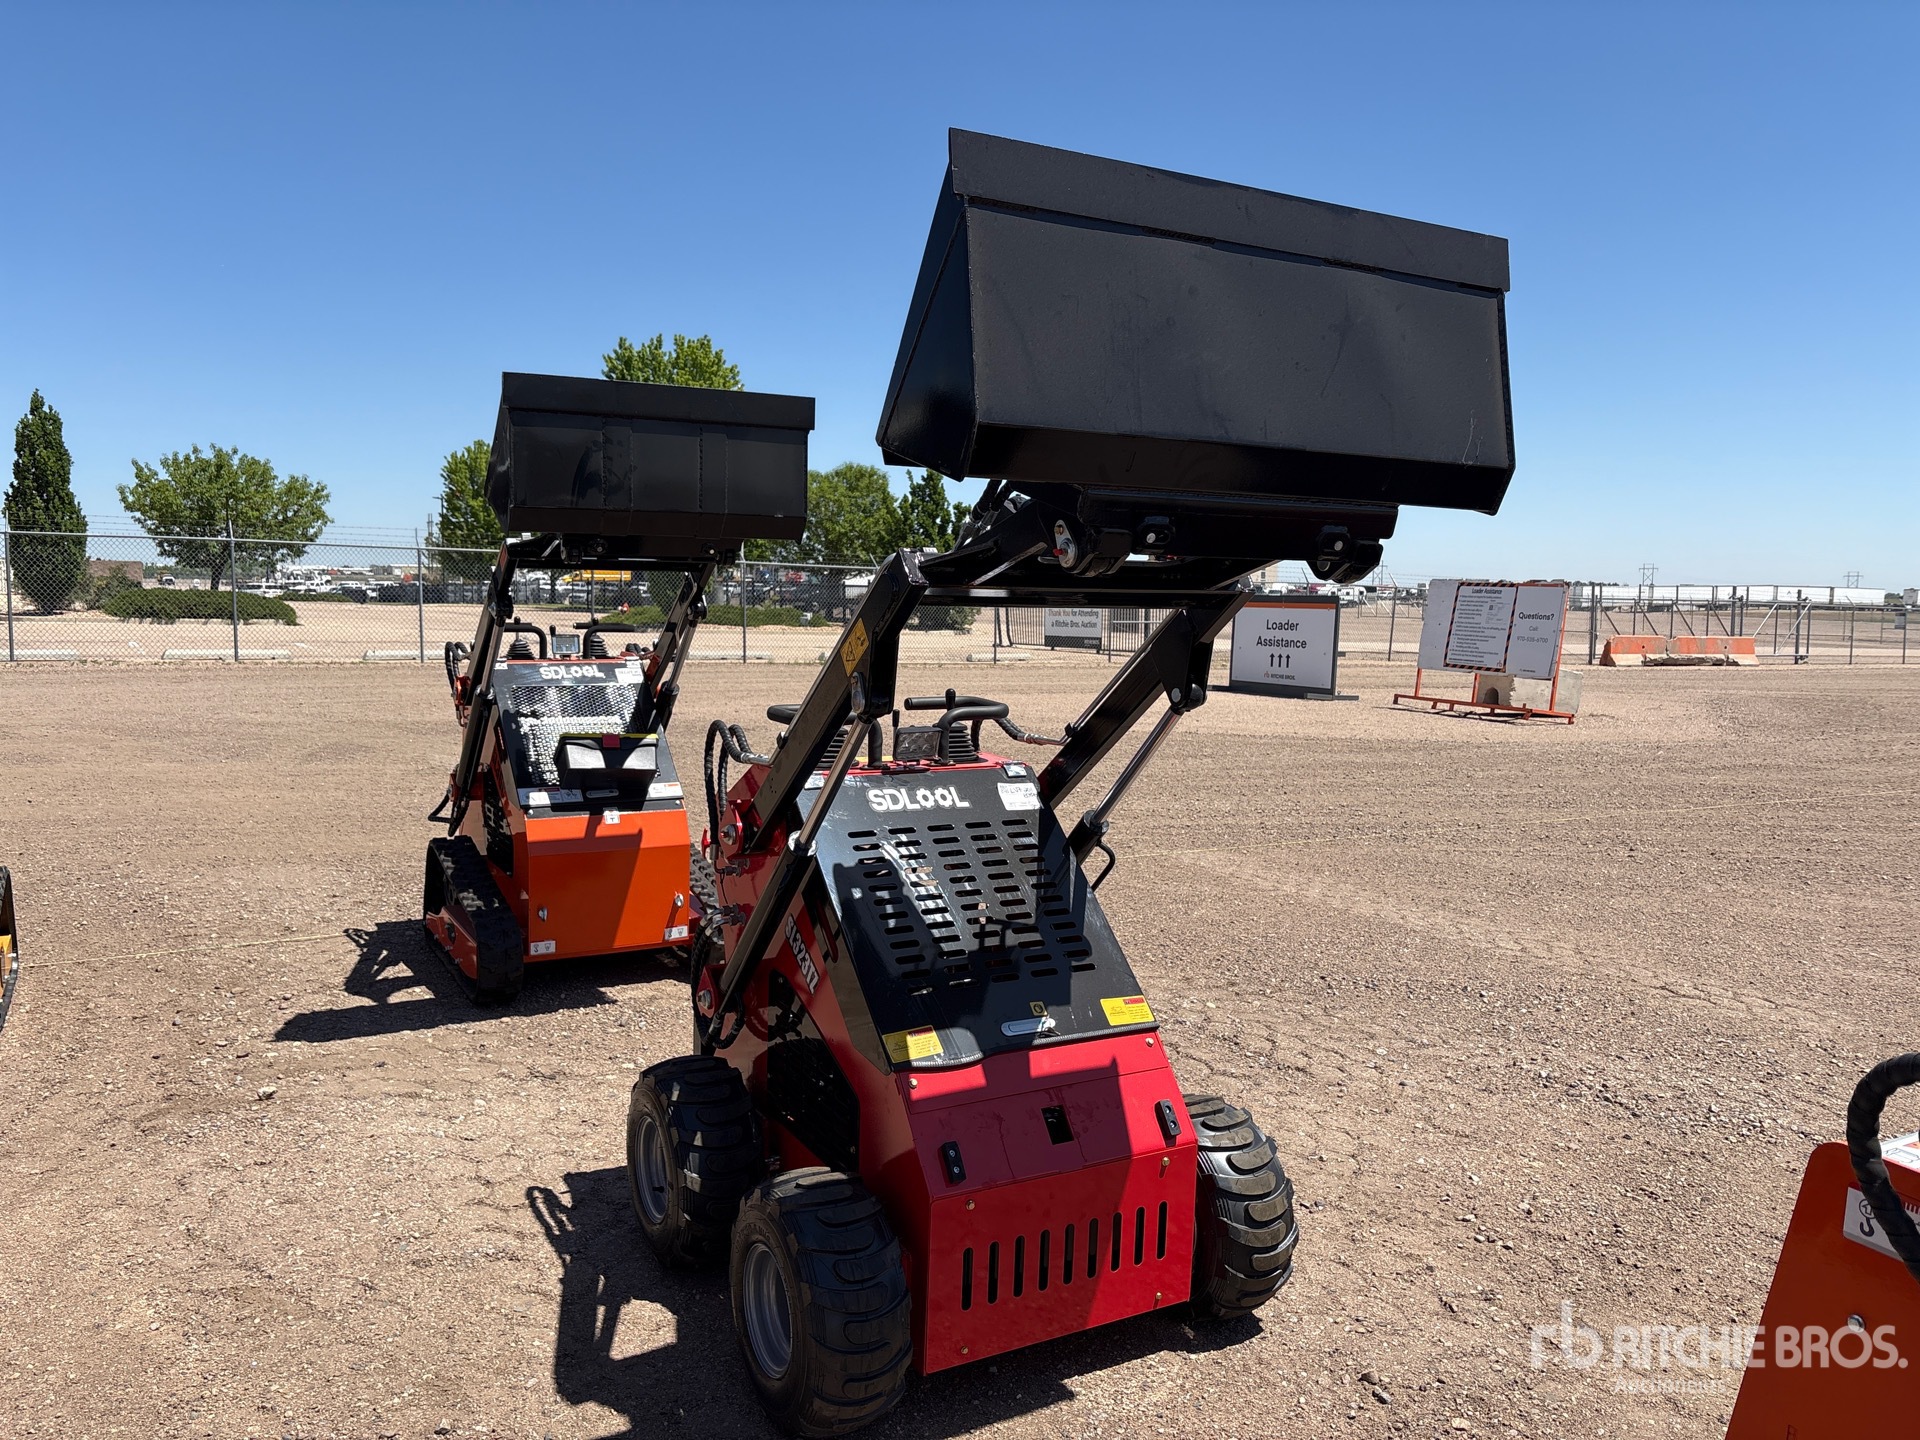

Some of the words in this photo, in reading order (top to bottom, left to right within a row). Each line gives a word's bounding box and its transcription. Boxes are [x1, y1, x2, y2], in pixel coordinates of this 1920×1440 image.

[1518, 612, 1555, 620] Questions?
[1266, 619, 1300, 631] Loader
[1256, 635, 1307, 649] Assistance
